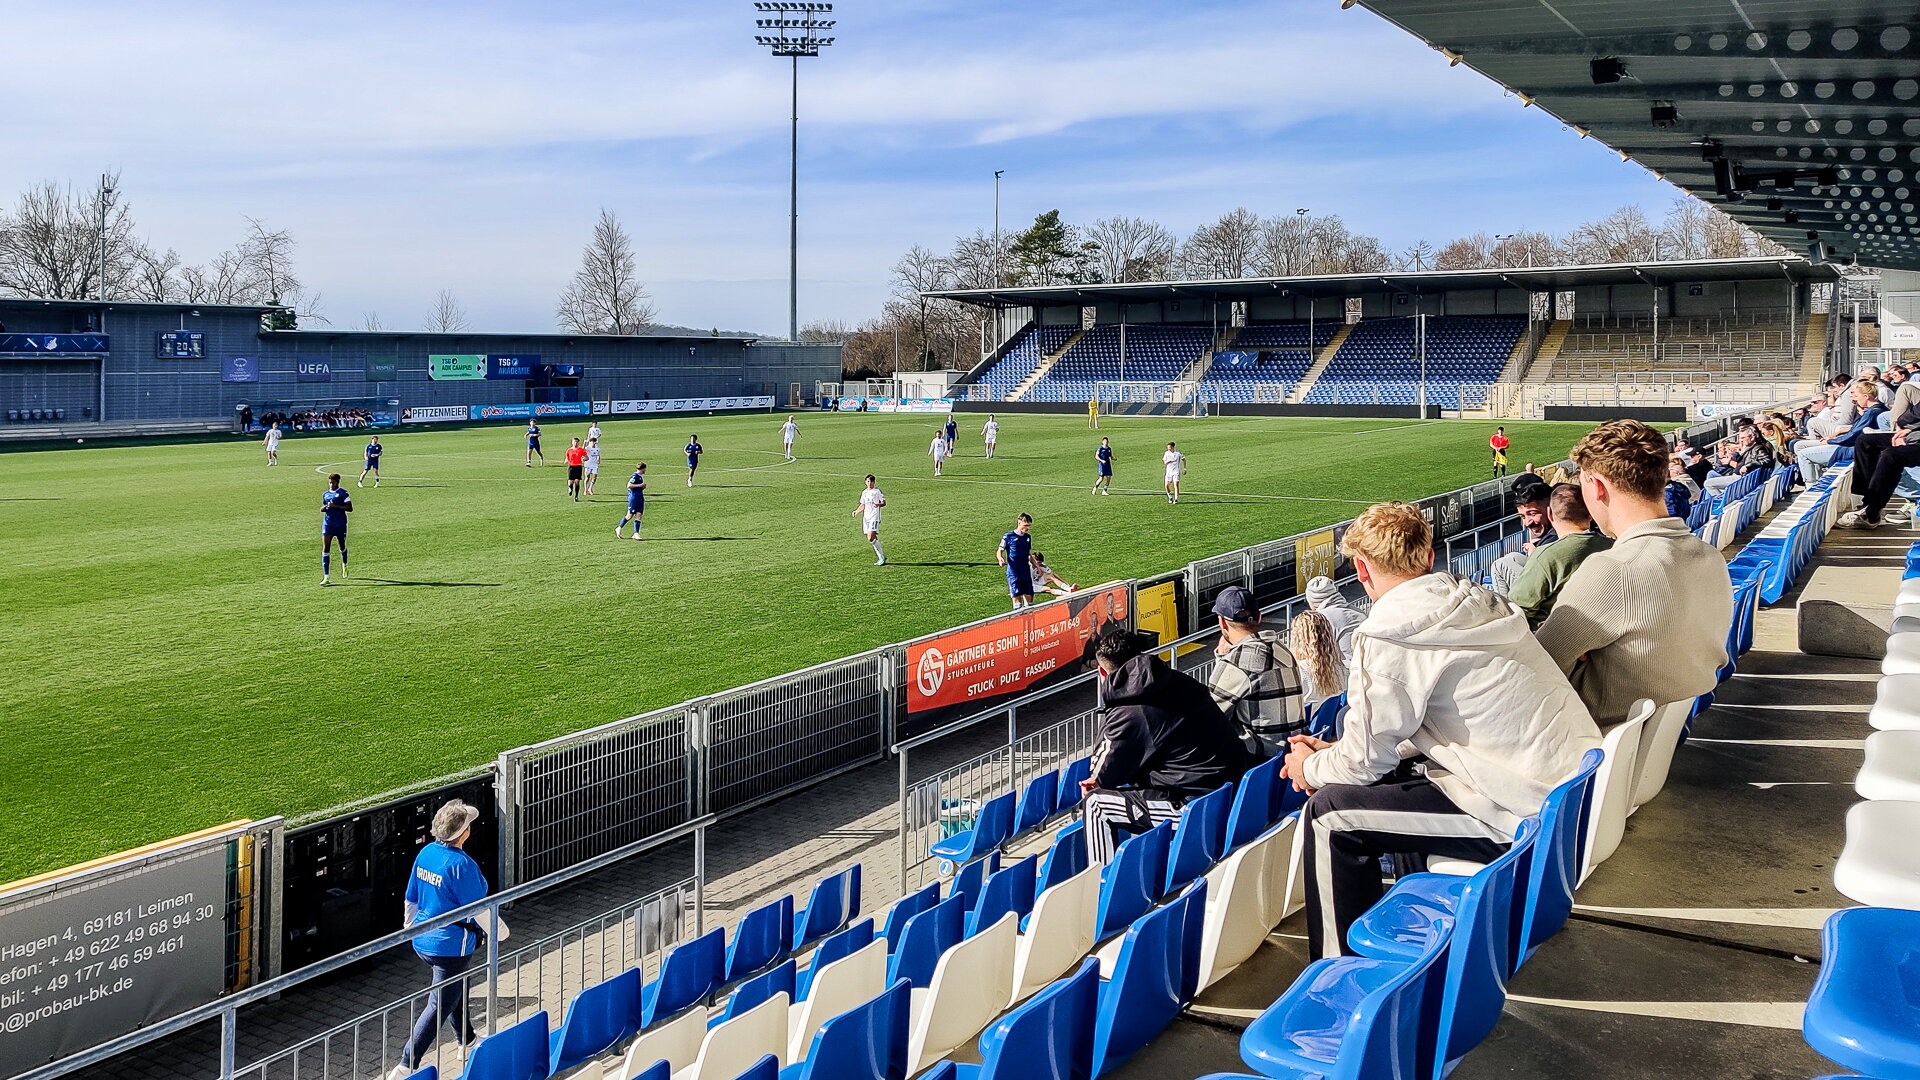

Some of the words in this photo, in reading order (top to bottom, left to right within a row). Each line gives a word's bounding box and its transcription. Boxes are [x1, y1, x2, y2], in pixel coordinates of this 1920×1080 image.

[176, 342, 188, 351] 20
[498, 358, 511, 367] TSG
[299, 363, 330, 374] UEFA
[498, 366, 531, 375] AKADEMIE
[655, 401, 667, 410] SAP
[674, 400, 685, 409] SAP
[692, 399, 703, 408] SAP
[709, 399, 720, 408] SAP
[726, 399, 736, 407] SAP
[743, 398, 753, 407] SAP
[759, 397, 768, 406] SAP
[594, 403, 606, 412] SAP
[617, 402, 629, 411] SAP
[637, 402, 648, 411] SAP
[412, 407, 467, 418] PFITZENMEIER
[1319, 560, 1329, 576] AG
[1029, 627, 1046, 643] 0174
[1050, 622, 1059, 636] 34
[1060, 620, 1067, 633] 71
[1067, 616, 1081, 630] 649
[946, 643, 987, 667] GÄRTNER
[988, 641, 995, 655] &
[996, 634, 1019, 652] SOHN
[947, 658, 995, 681] STUCKATEURE
[967, 678, 995, 697] STUCK
[1000, 669, 1021, 686] PUTZ
[1025, 658, 1056, 678] FASSADE
[1, 934, 58, 962] Hagen
[62, 926, 78, 942] 4,
[83, 908, 132, 935] 69181
[138, 892, 194, 919] Leimen
[48, 956, 60, 967] +
[64, 946, 85, 963] 49
[90, 937, 120, 956] 622
[124, 926, 145, 944] 49
[149, 919, 168, 937] 68
[172, 911, 191, 929] 94
[195, 904, 214, 922] 30
[31, 985, 43, 996] +
[46, 974, 69, 992] 49
[74, 961, 104, 984] 177
[108, 953, 129, 971] 46
[133, 946, 153, 964] 59
[157, 934, 184, 955] 461
